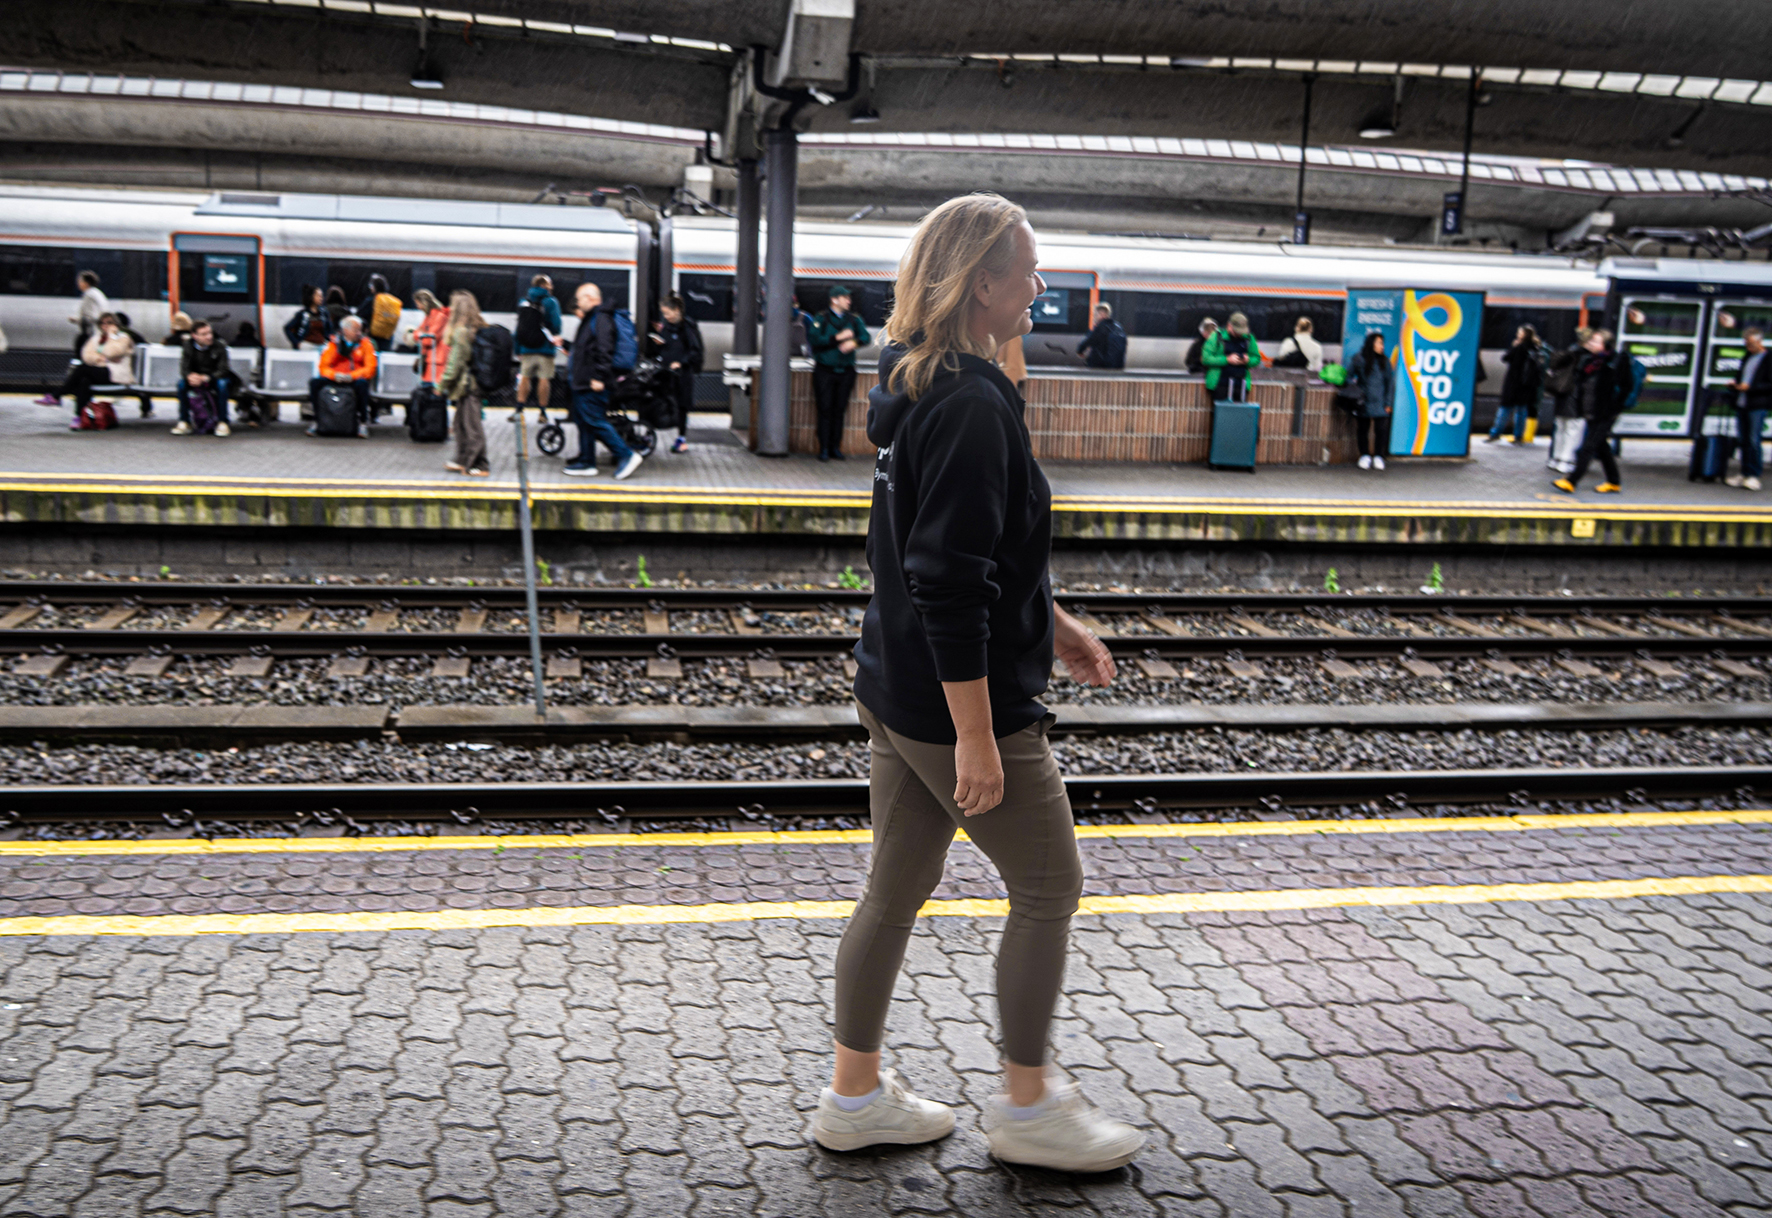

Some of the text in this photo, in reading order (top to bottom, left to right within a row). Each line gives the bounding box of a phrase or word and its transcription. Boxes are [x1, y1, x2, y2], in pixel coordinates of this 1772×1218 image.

[1410, 350, 1460, 373] JOY
[1416, 375, 1452, 399] TO
[1428, 401, 1465, 425] GO
